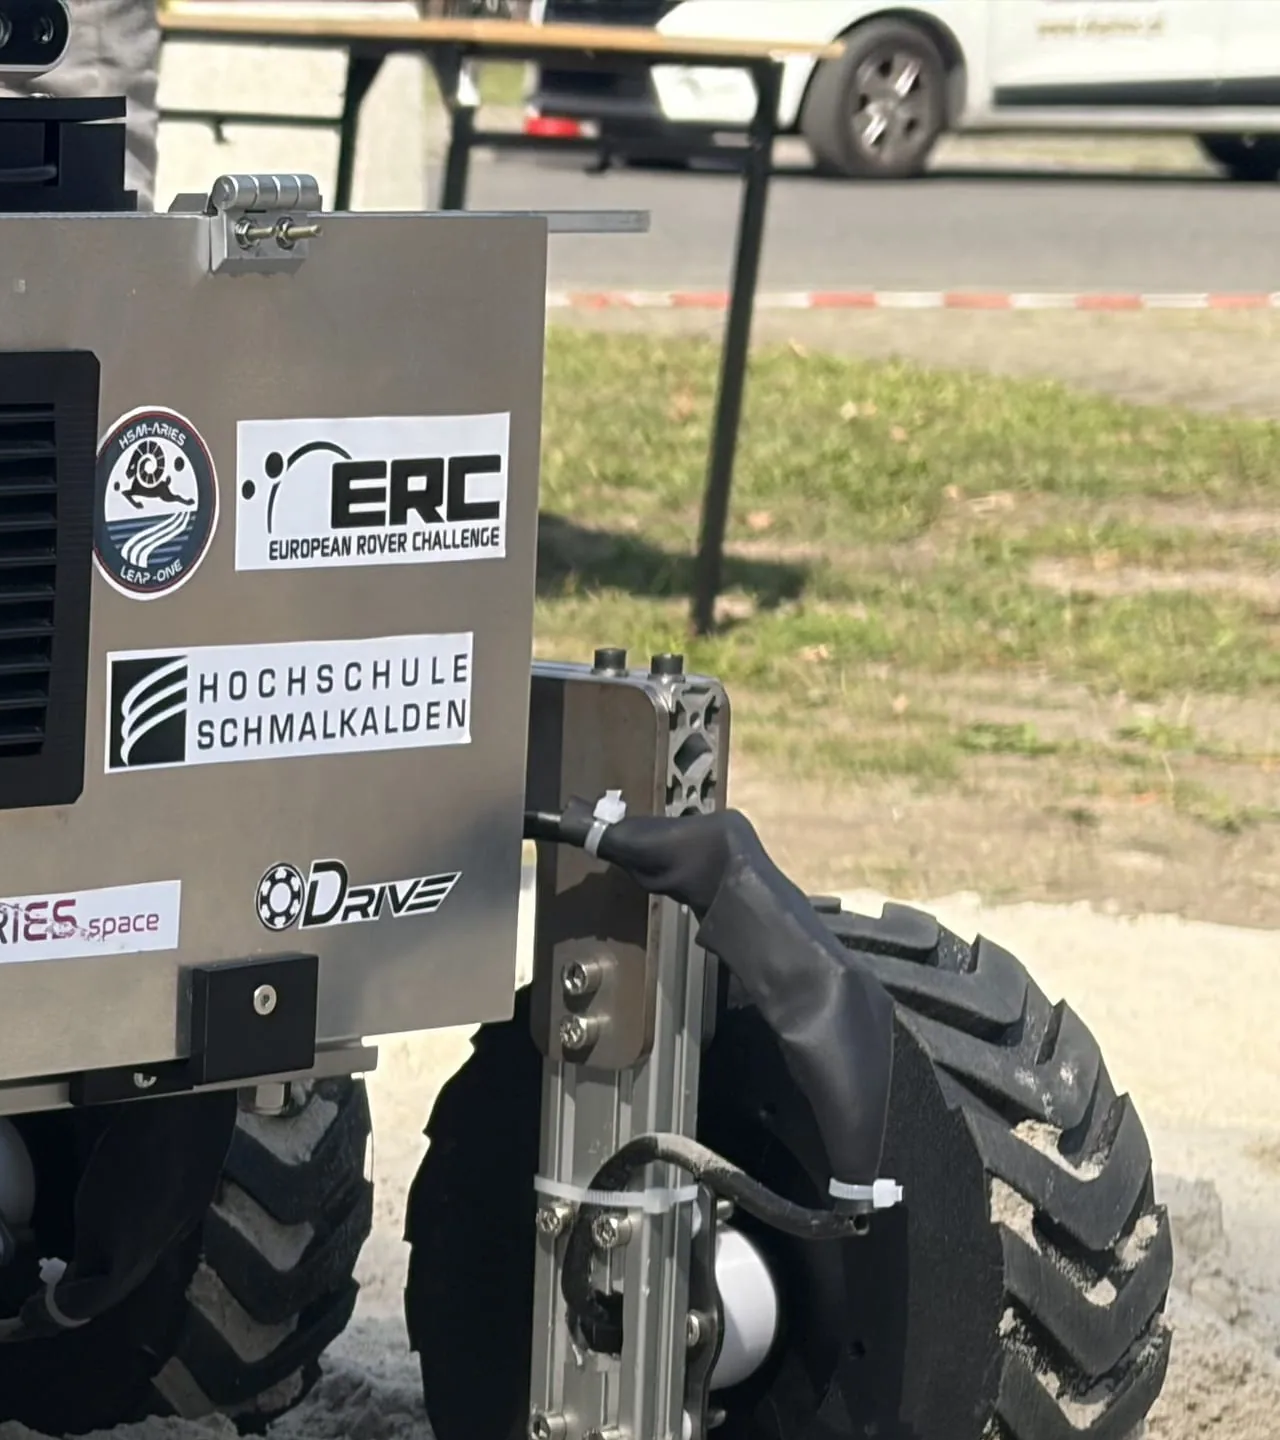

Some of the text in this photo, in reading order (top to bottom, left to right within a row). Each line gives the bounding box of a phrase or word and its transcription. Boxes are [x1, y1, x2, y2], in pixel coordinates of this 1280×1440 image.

[119, 422, 186, 449] HSM-ARIES
[332, 455, 501, 529] ERC
[270, 527, 499, 560] EUROPEAN ROVER CHALLENGE
[199, 654, 468, 703] HOCHSCHULE
[197, 699, 467, 750] SCHMALKALDEN
[89, 913, 159, 942] space
